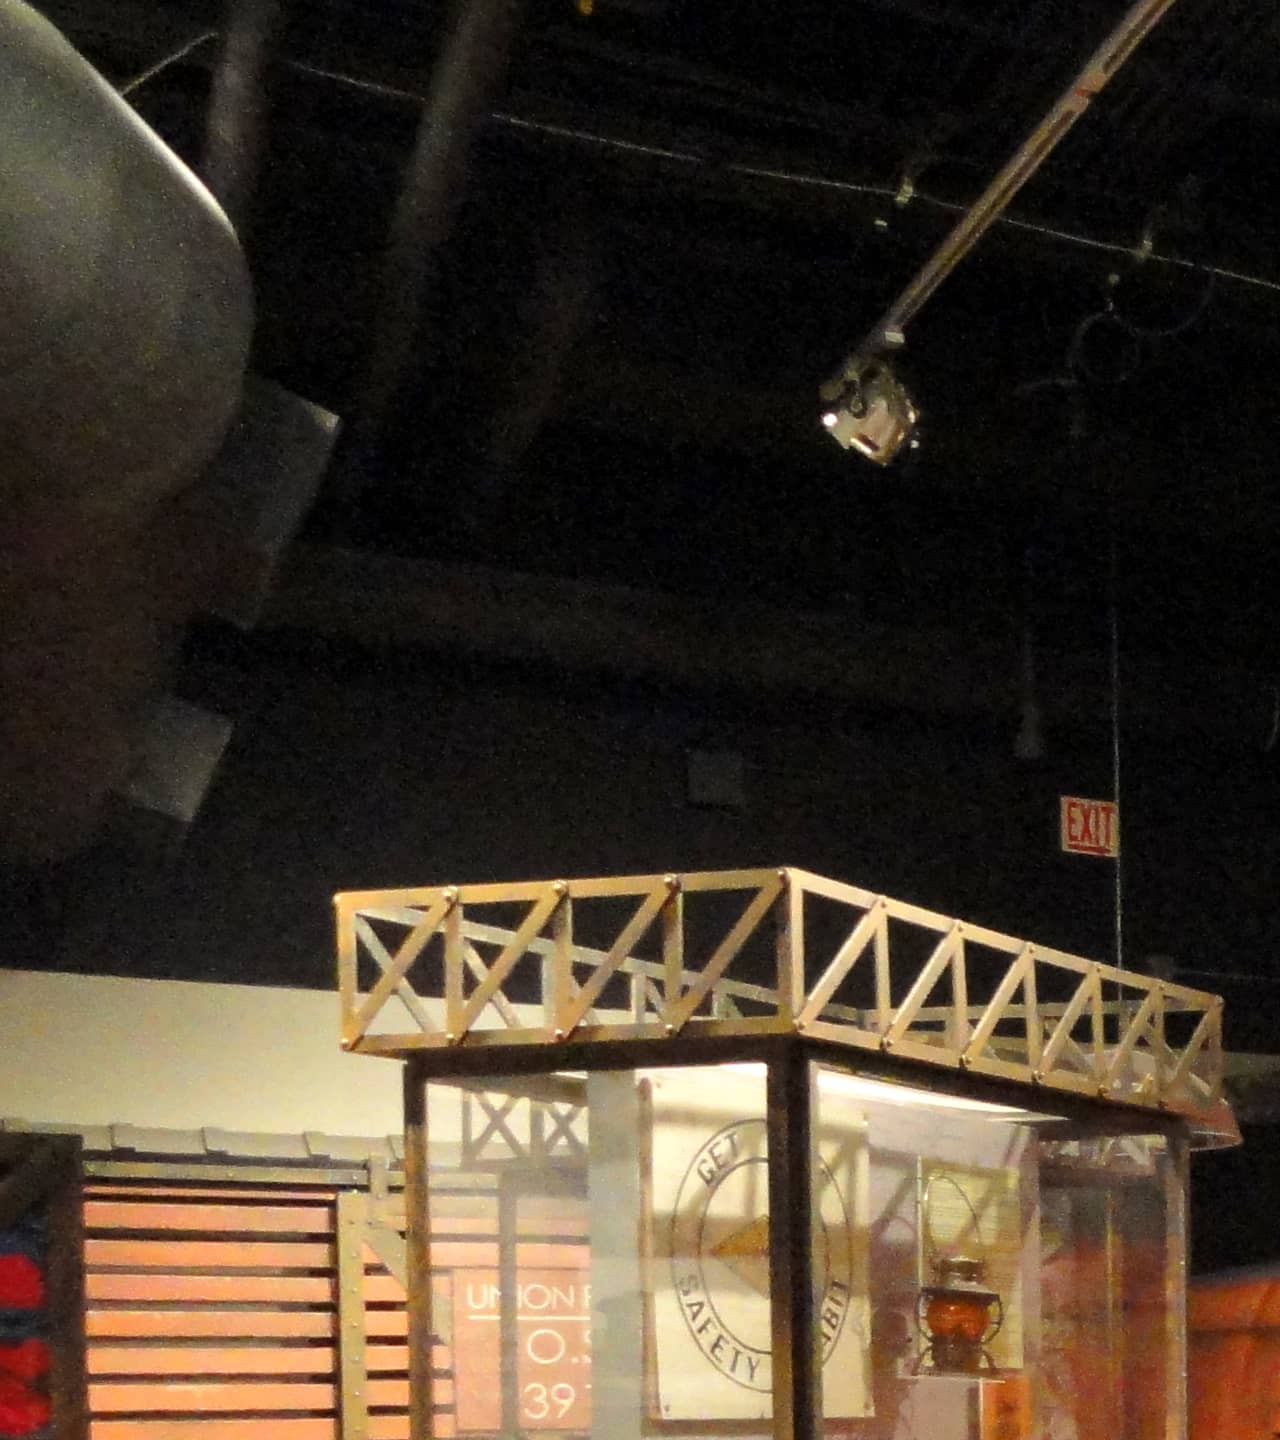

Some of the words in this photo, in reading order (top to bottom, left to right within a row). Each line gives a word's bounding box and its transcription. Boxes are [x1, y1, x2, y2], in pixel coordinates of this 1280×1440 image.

[1067, 801, 1114, 849] EXIT
[696, 1132, 739, 1187] GET
[679, 1273, 761, 1382] SAFETY
